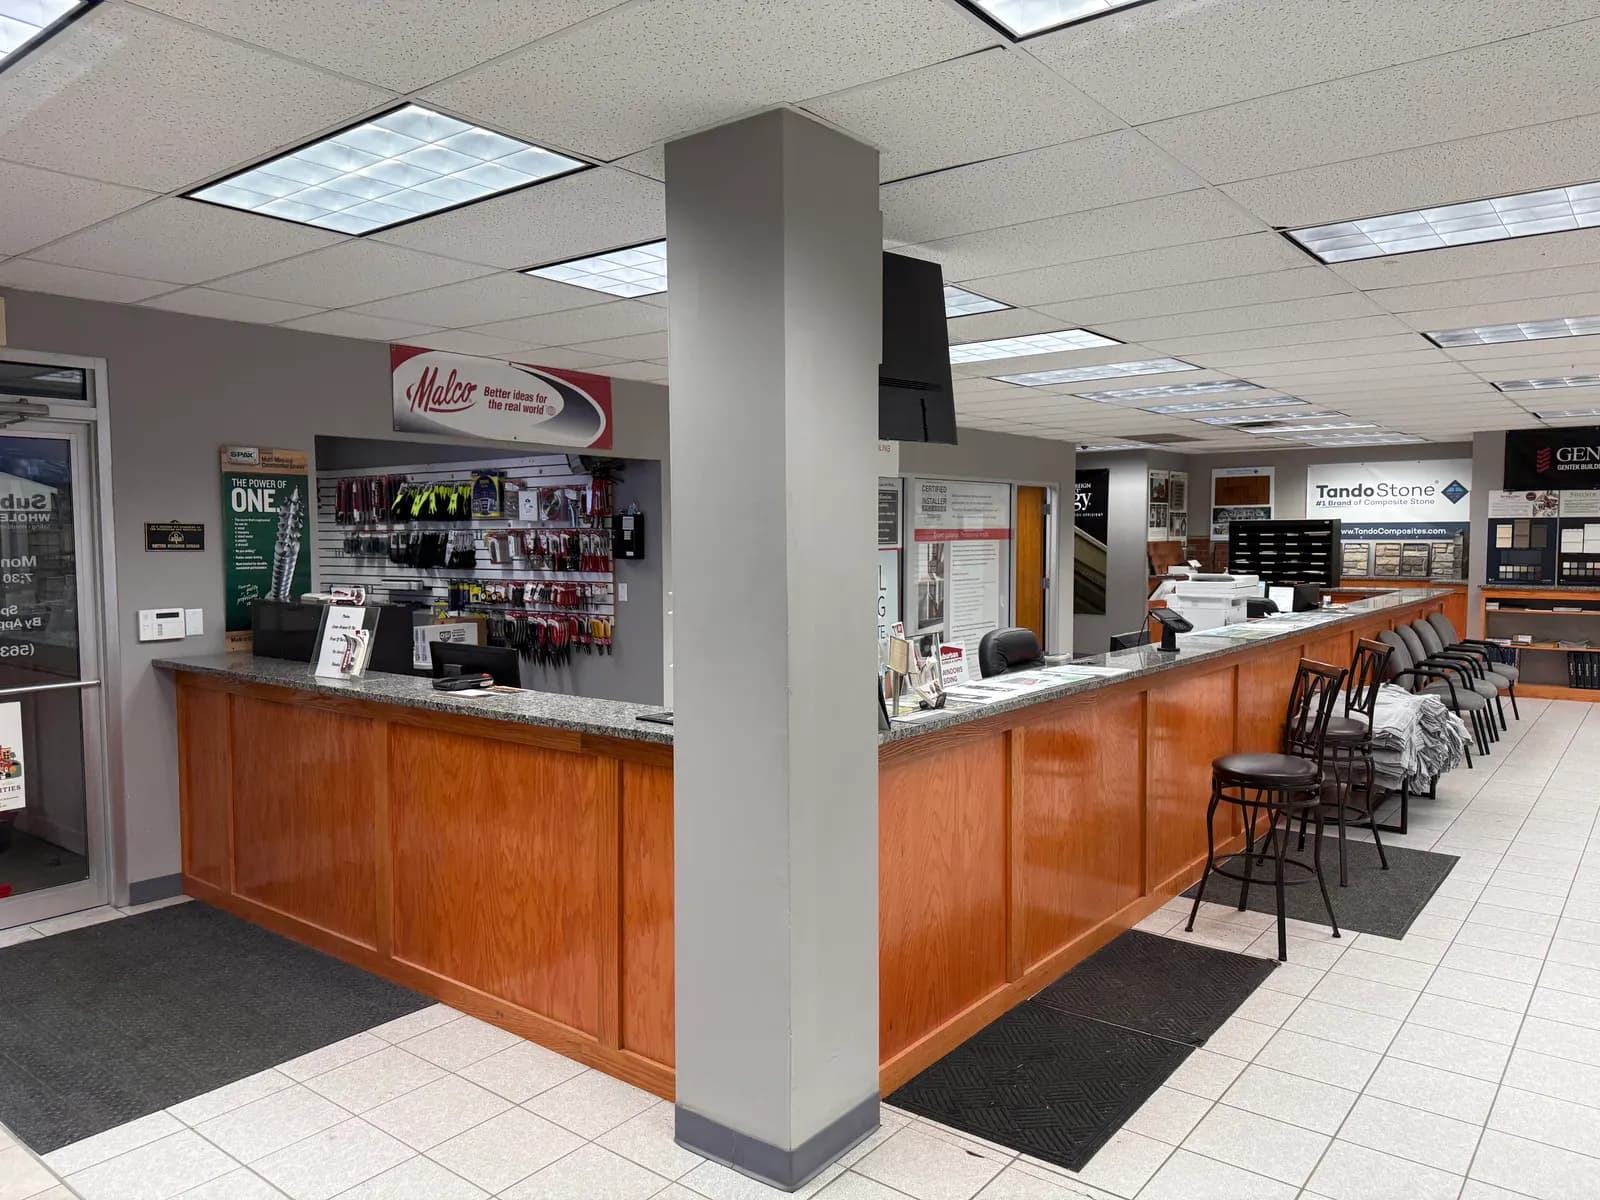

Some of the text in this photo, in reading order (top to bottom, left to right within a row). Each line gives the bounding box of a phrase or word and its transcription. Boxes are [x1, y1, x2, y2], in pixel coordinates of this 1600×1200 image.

[406, 366, 477, 413] Malco
[484, 386, 548, 404] Better ideas for
[488, 399, 545, 415] the real world
[1556, 447, 1600, 462] GEN
[231, 478, 287, 489] THE POWER OF
[921, 485, 947, 494] CERTIFIED
[231, 487, 280, 513] ONE.
[921, 497, 947, 506] INSTALLER
[1364, 499, 1408, 508] Composite
